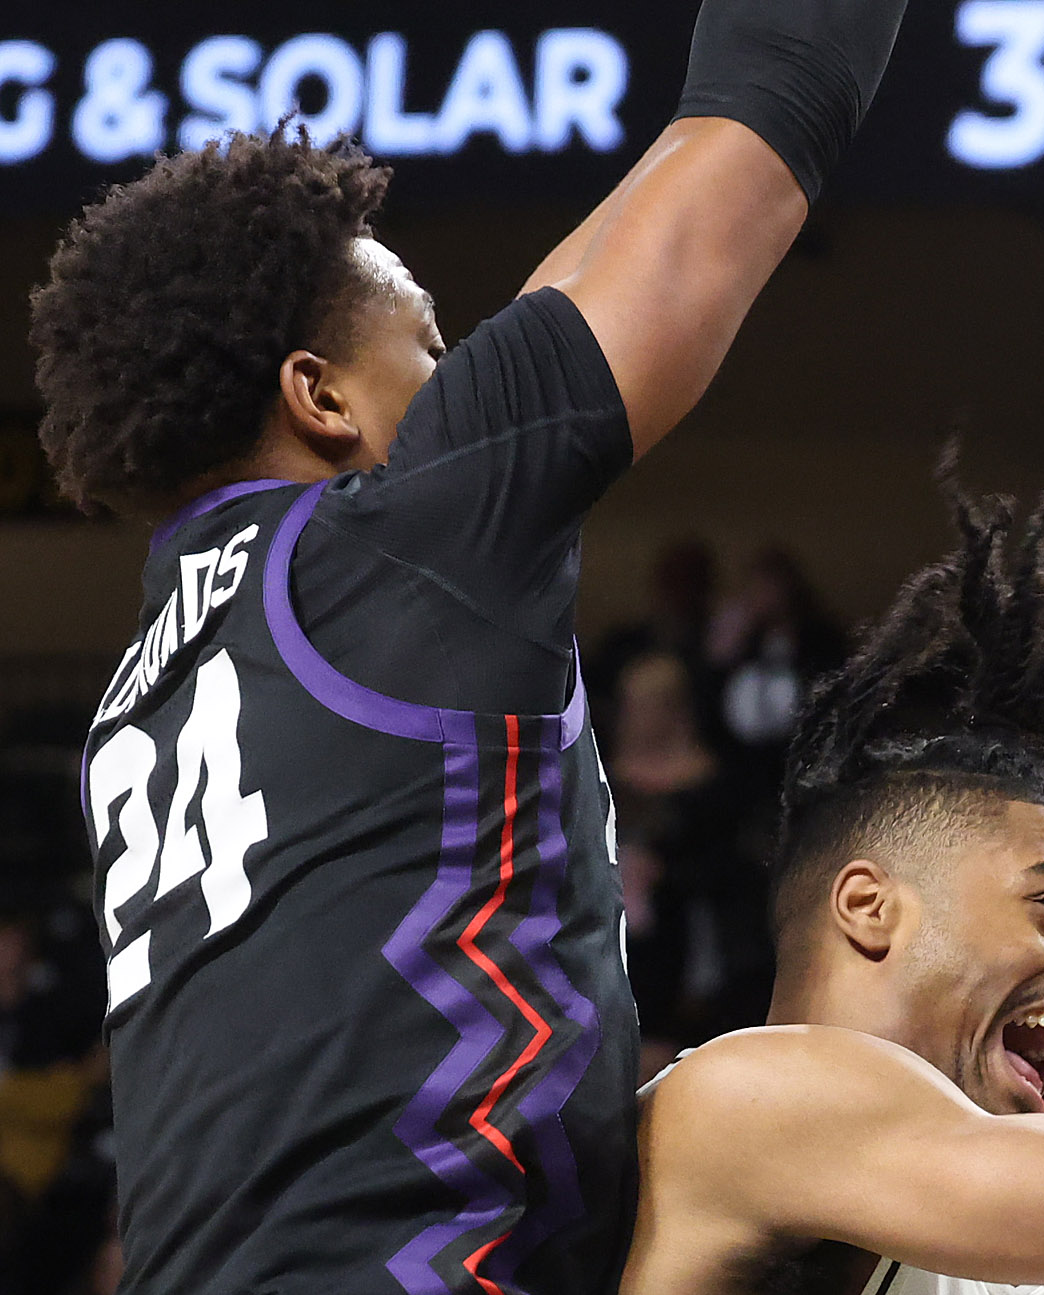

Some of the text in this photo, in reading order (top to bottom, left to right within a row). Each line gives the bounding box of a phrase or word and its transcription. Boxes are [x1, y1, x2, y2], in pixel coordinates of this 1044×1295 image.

[71, 37, 169, 165] &
[178, 30, 628, 158] SOLAR
[88, 647, 269, 1018] 24
